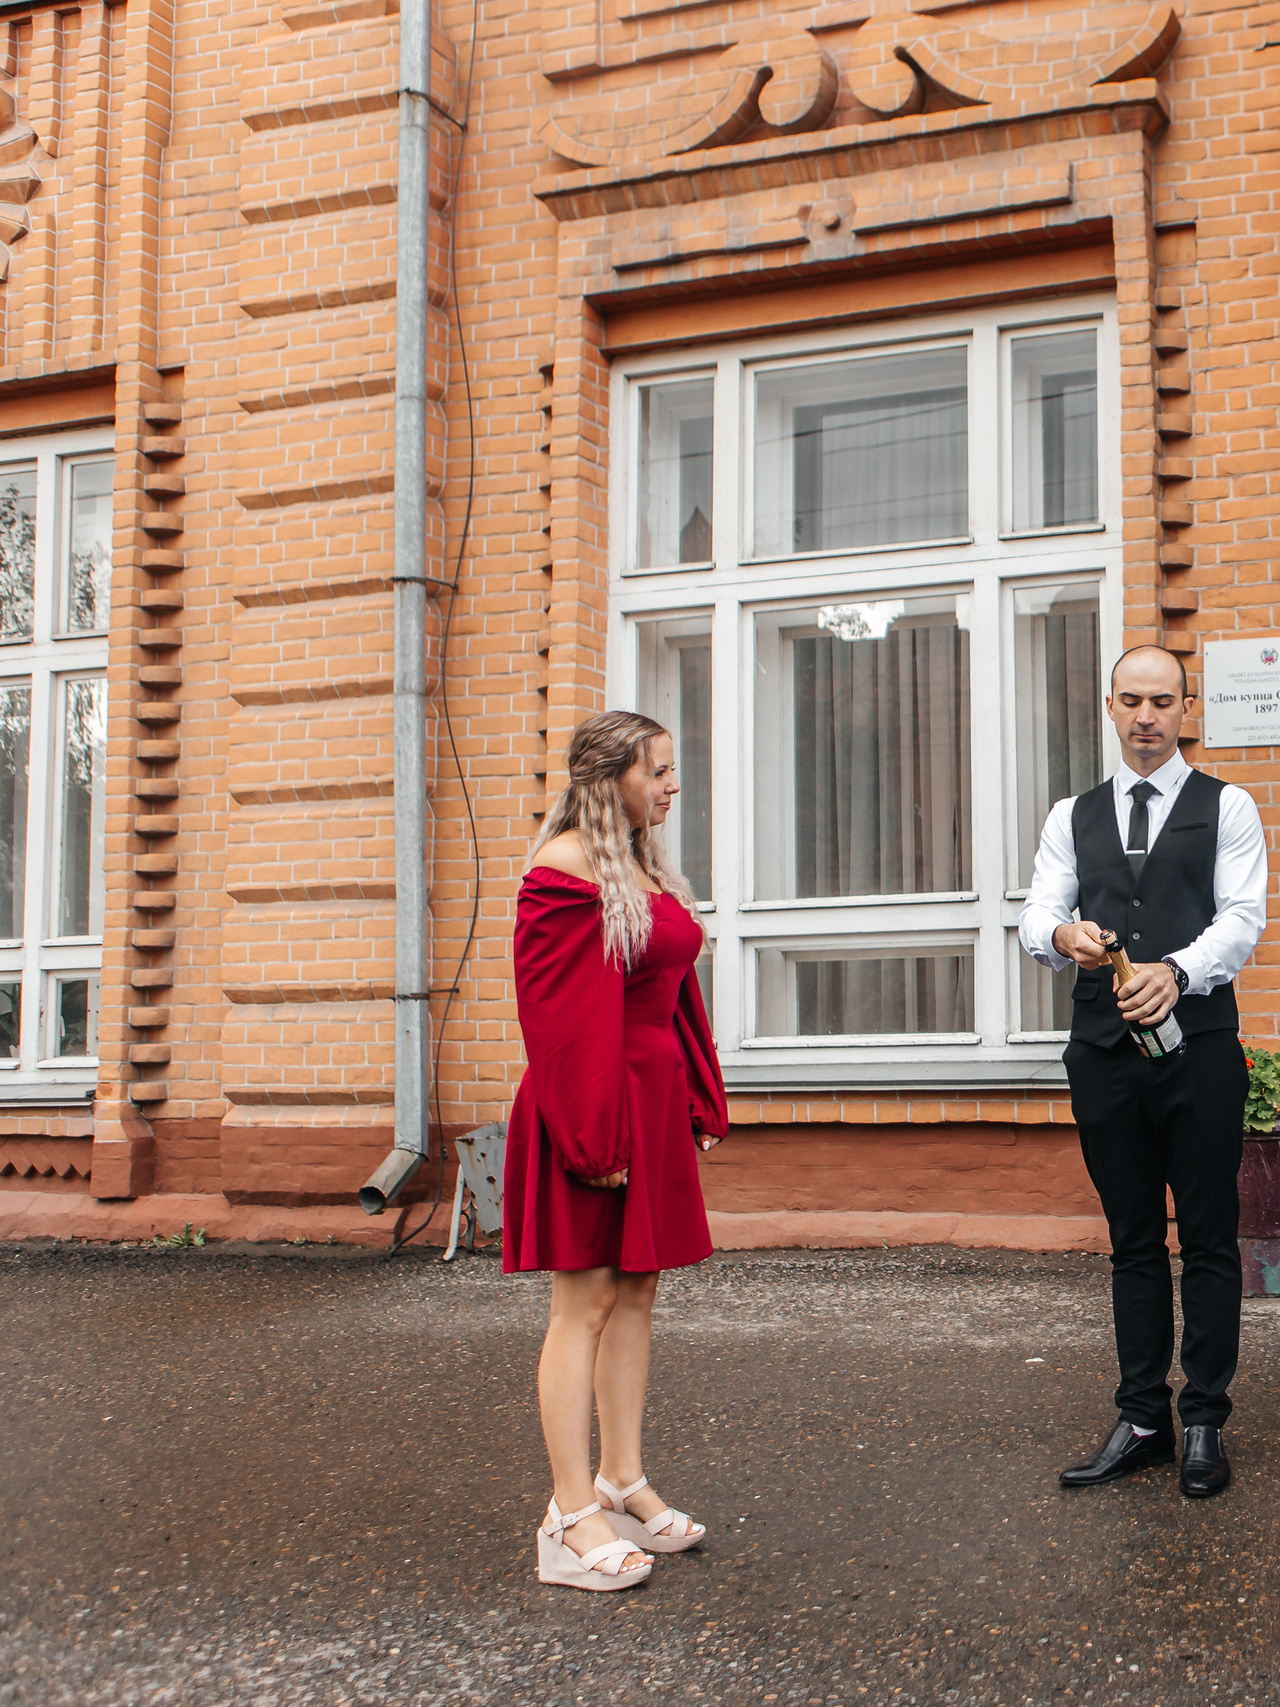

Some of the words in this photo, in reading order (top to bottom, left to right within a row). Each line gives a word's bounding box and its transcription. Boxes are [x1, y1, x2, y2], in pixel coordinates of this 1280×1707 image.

[1227, 671, 1247, 679] ОБЪЕКТ
[1209, 692, 1237, 704] «Дом
[1240, 692, 1273, 704] купца
[1255, 703, 1279, 714] 1897
